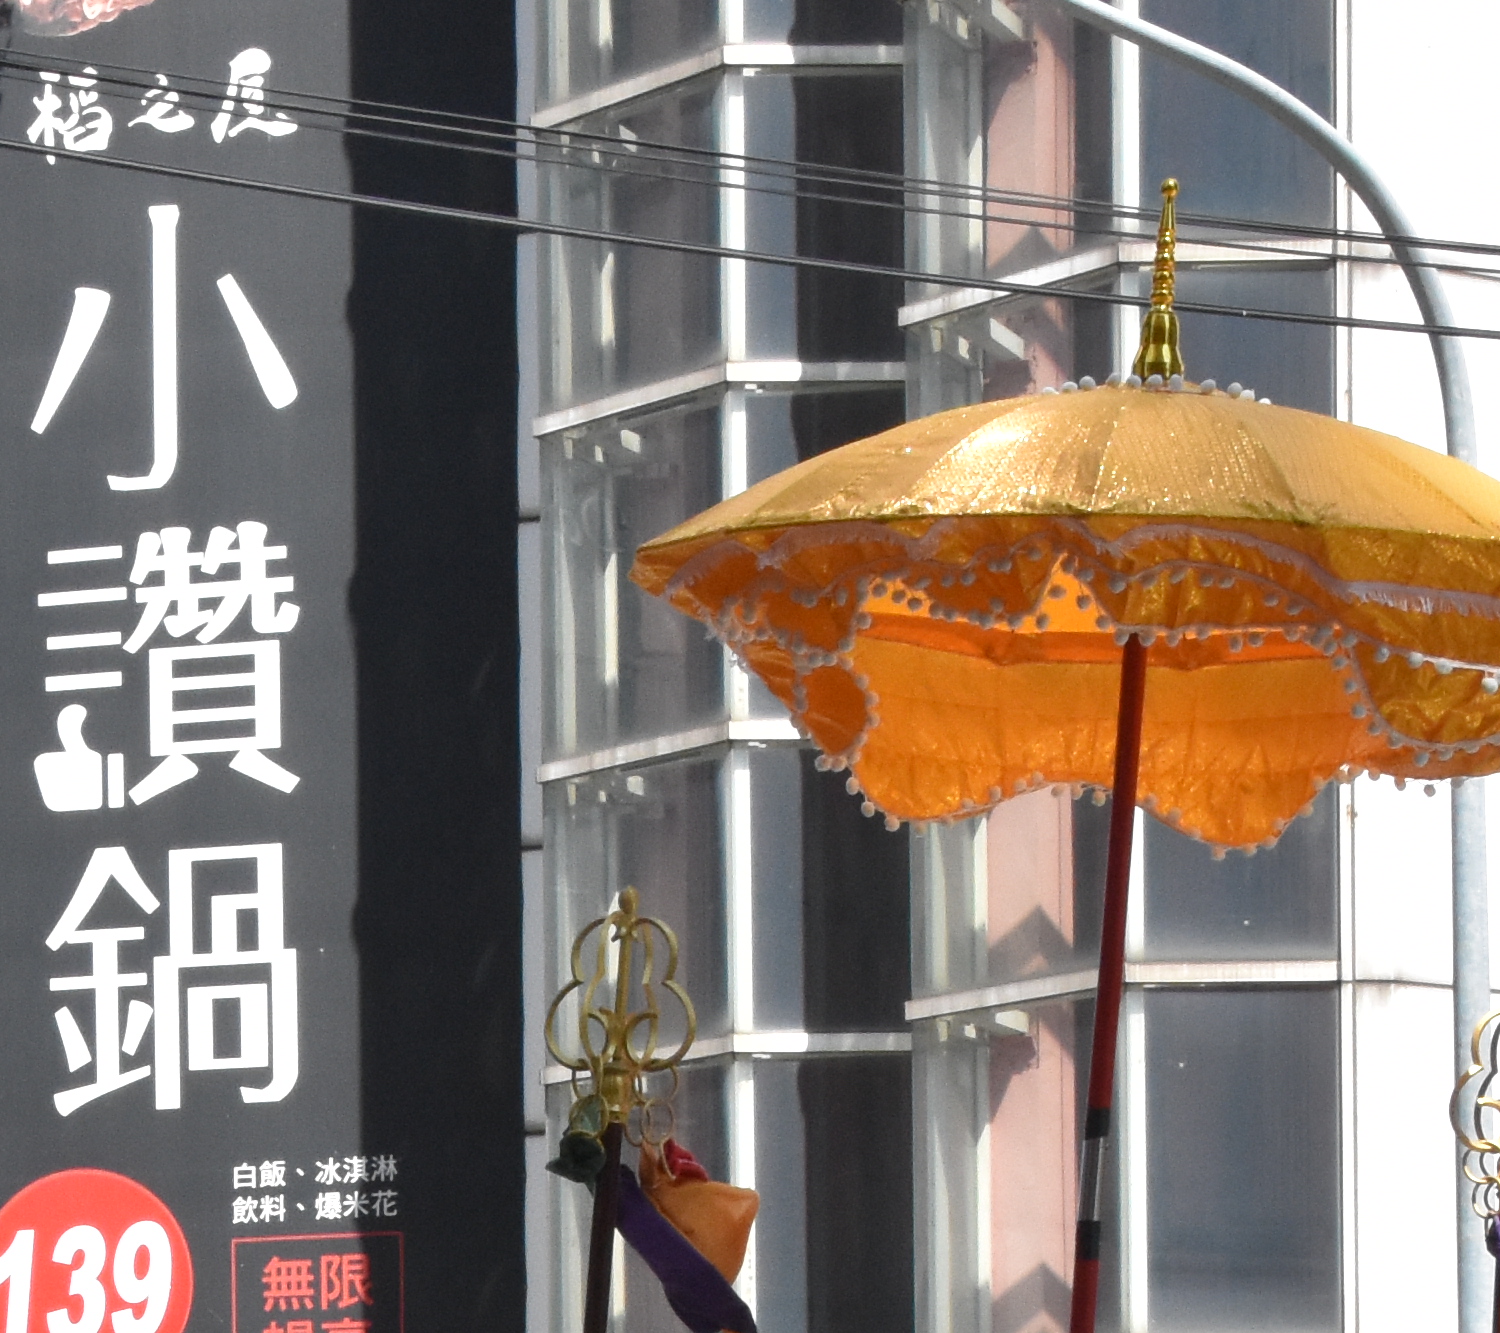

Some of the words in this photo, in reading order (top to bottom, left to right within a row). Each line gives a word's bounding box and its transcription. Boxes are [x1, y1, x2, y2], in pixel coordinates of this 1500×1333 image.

[232, 1156, 398, 1189] 白飯、冰淇淋
[232, 1189, 398, 1223] 飲料、爆米花
[262, 1254, 372, 1311] 無限
